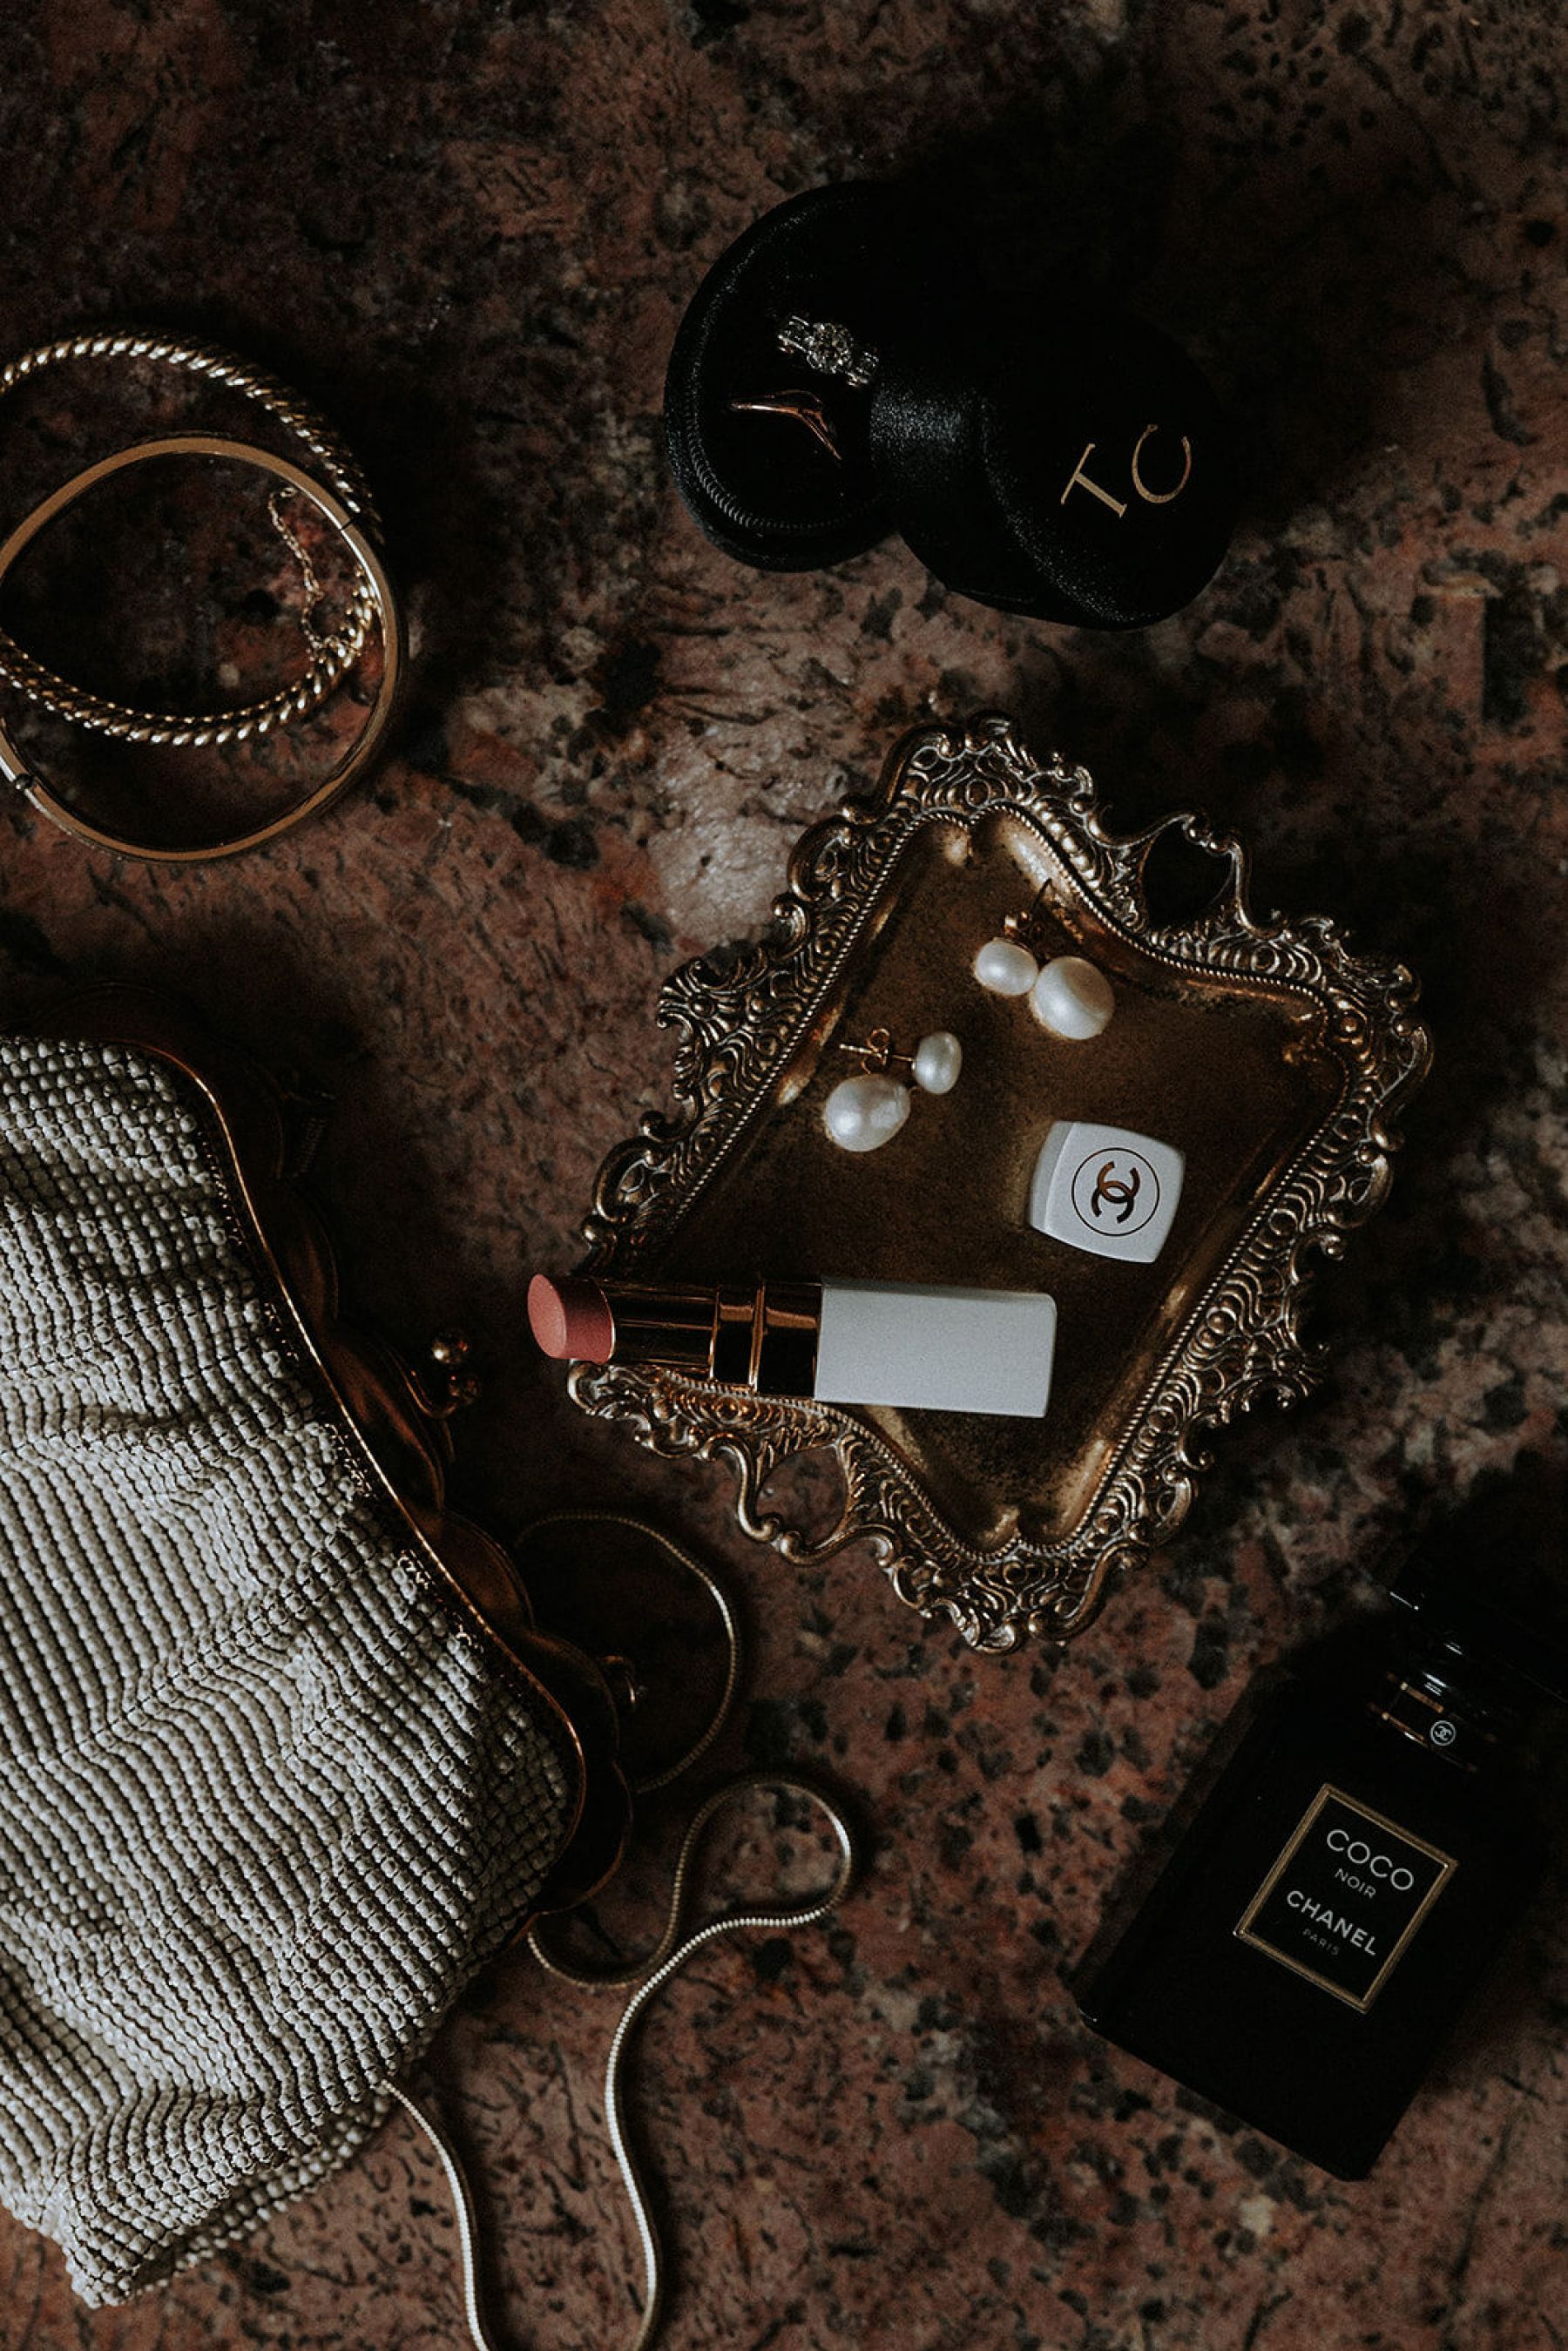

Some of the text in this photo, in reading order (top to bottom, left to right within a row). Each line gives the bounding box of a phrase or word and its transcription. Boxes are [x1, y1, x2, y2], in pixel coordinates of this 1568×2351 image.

[1327, 1829, 1414, 1890] COCO
[1334, 1868, 1376, 1899] NOIR
[1287, 1890, 1375, 1956] CHANEL
[1303, 1929, 1340, 1956] PARIS
